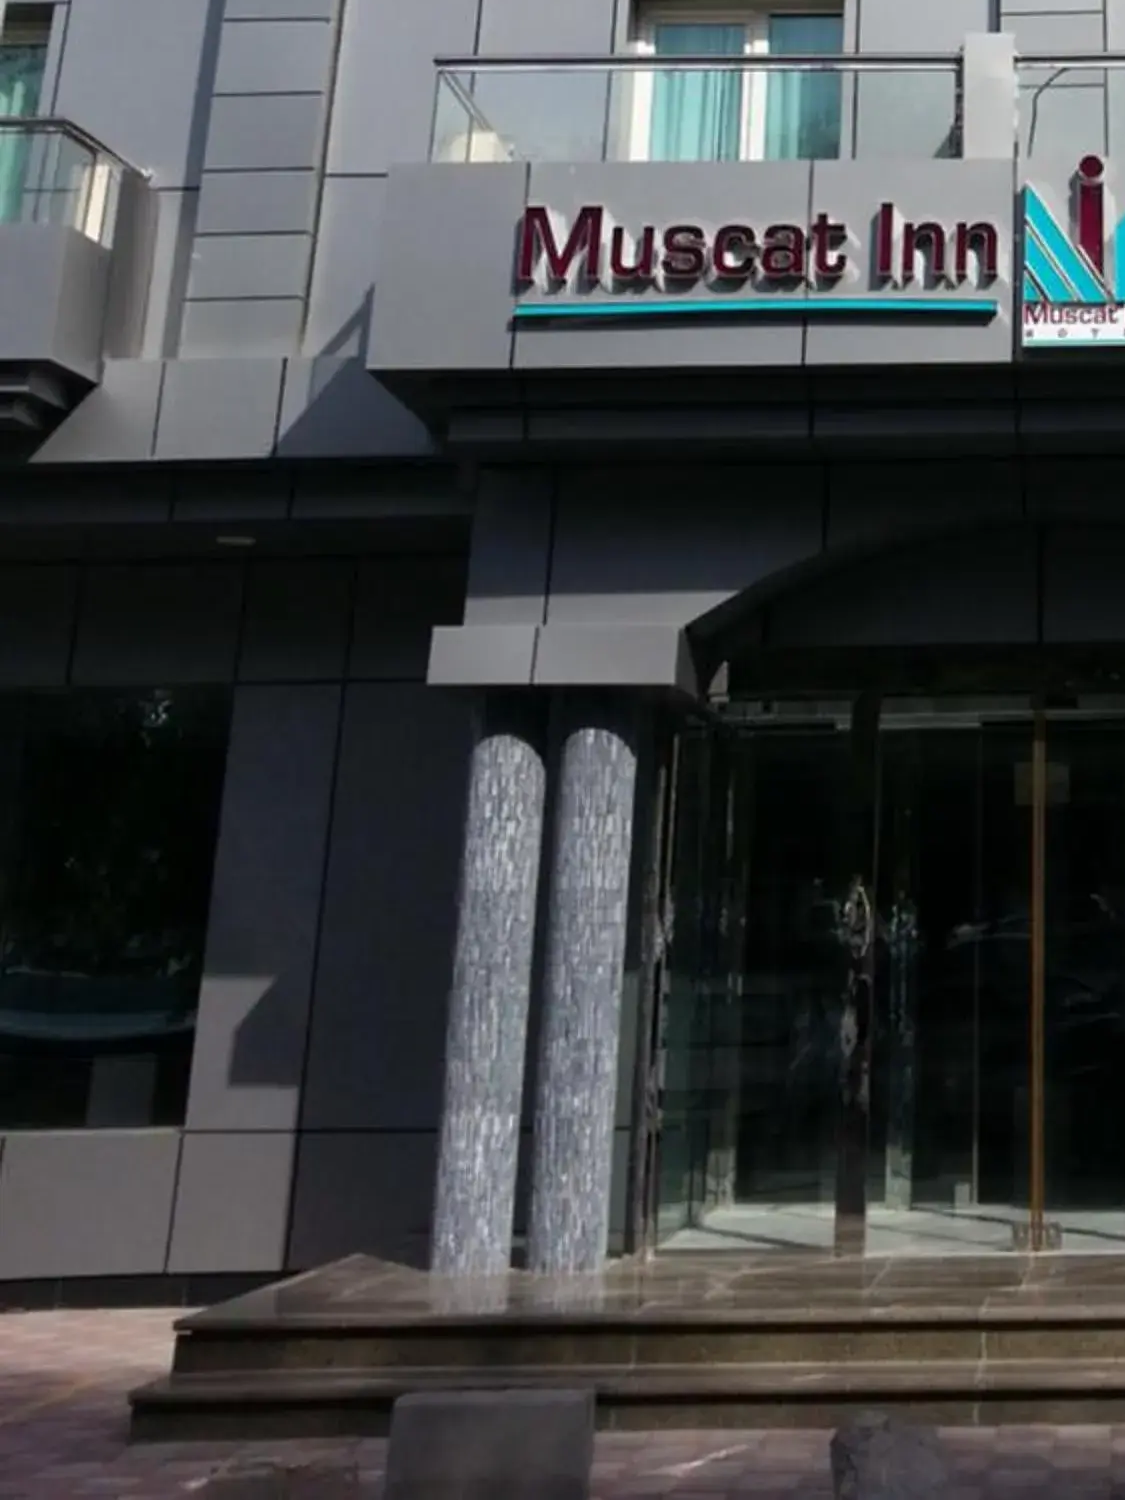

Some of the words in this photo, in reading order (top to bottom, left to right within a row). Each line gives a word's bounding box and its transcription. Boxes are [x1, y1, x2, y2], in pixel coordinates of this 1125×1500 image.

[519, 205, 846, 280] Muscat
[876, 202, 998, 277] Inn
[1024, 304, 1118, 324] Muscat
